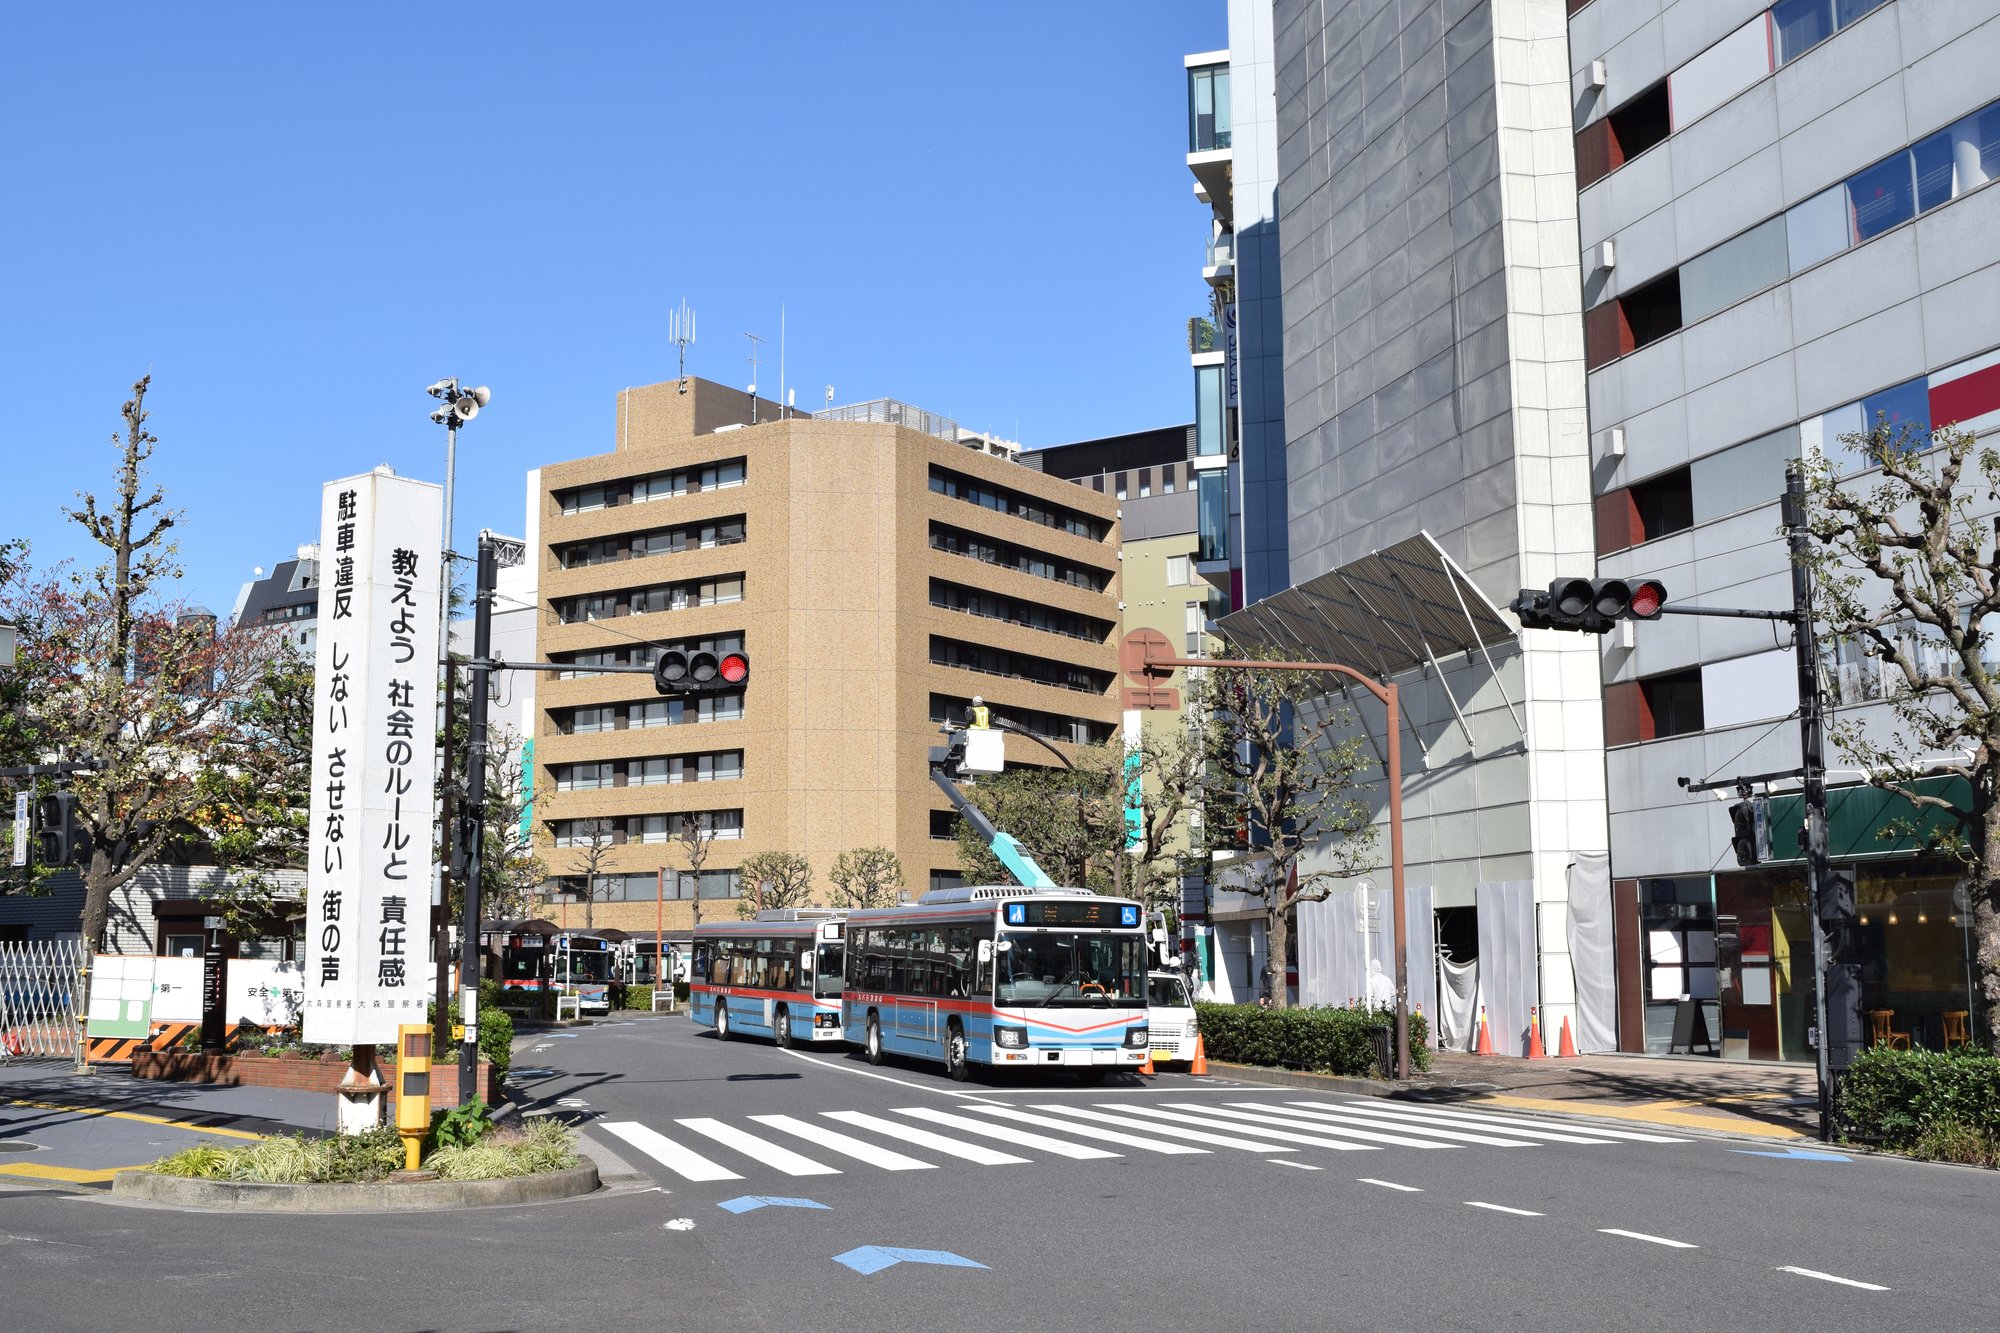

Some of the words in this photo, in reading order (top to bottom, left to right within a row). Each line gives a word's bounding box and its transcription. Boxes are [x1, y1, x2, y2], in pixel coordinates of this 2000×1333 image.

[334, 489, 357, 620] 駐車違反
[390, 547, 419, 664] 教えよう
[329, 642, 349, 734] しない
[324, 747, 347, 874] させない
[382, 678, 414, 880] 社会のルールと
[320, 889, 342, 988] 街の声
[377, 895, 407, 988] 責任感
[160, 983, 182, 993] 第一
[247, 986, 269, 997] 安全
[358, 999, 424, 1009] 大森警察署
